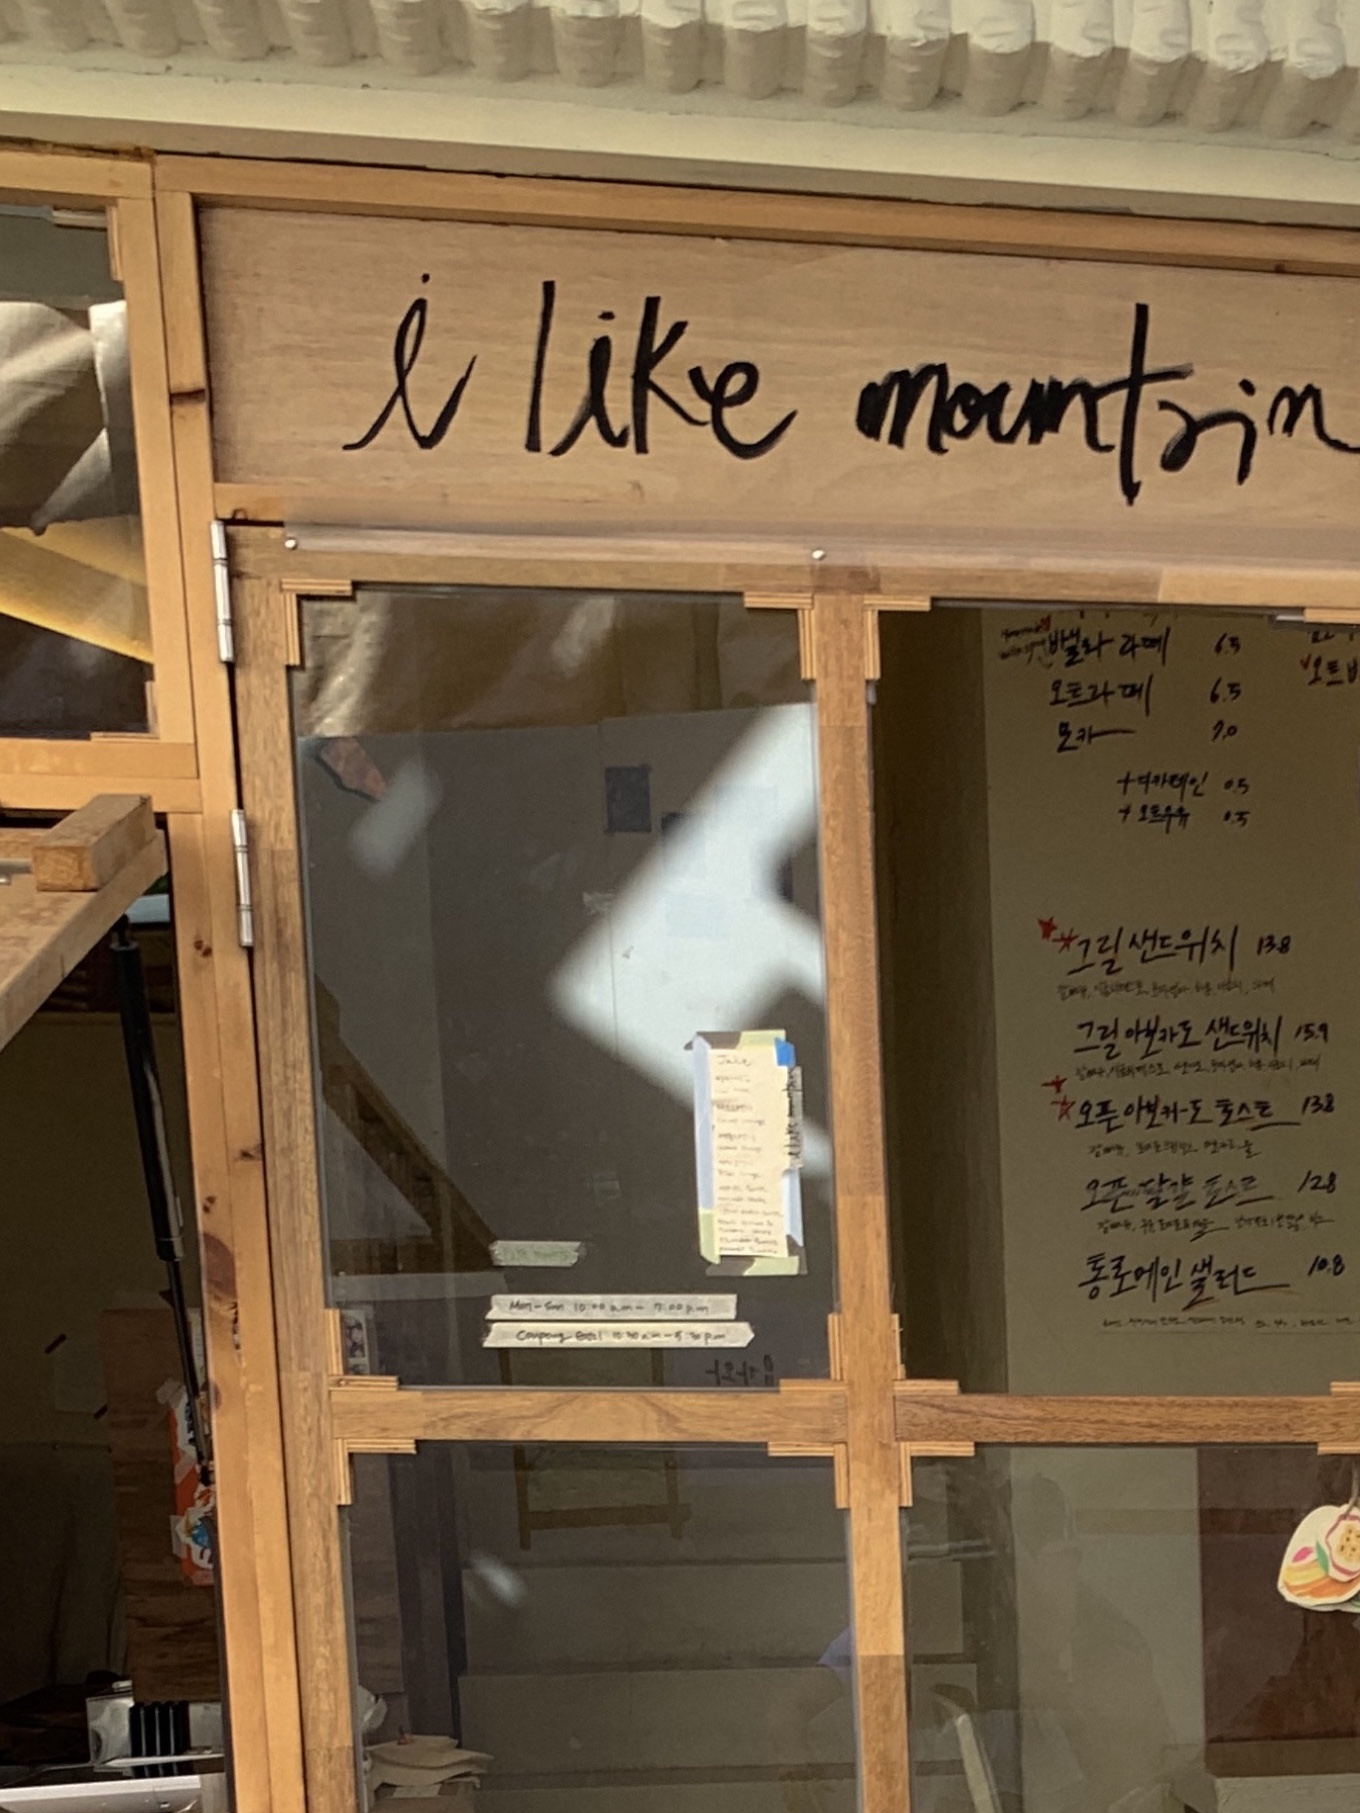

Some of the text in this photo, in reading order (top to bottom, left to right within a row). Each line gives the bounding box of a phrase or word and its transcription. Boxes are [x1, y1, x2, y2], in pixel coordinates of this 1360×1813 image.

[525, 280, 798, 460] like
[1067, 925, 1124, 976] 그릴
[1128, 924, 1239, 973] 샌드위치
[1073, 1016, 1121, 1062] 그릴
[1204, 1014, 1284, 1056] 샌드위치
